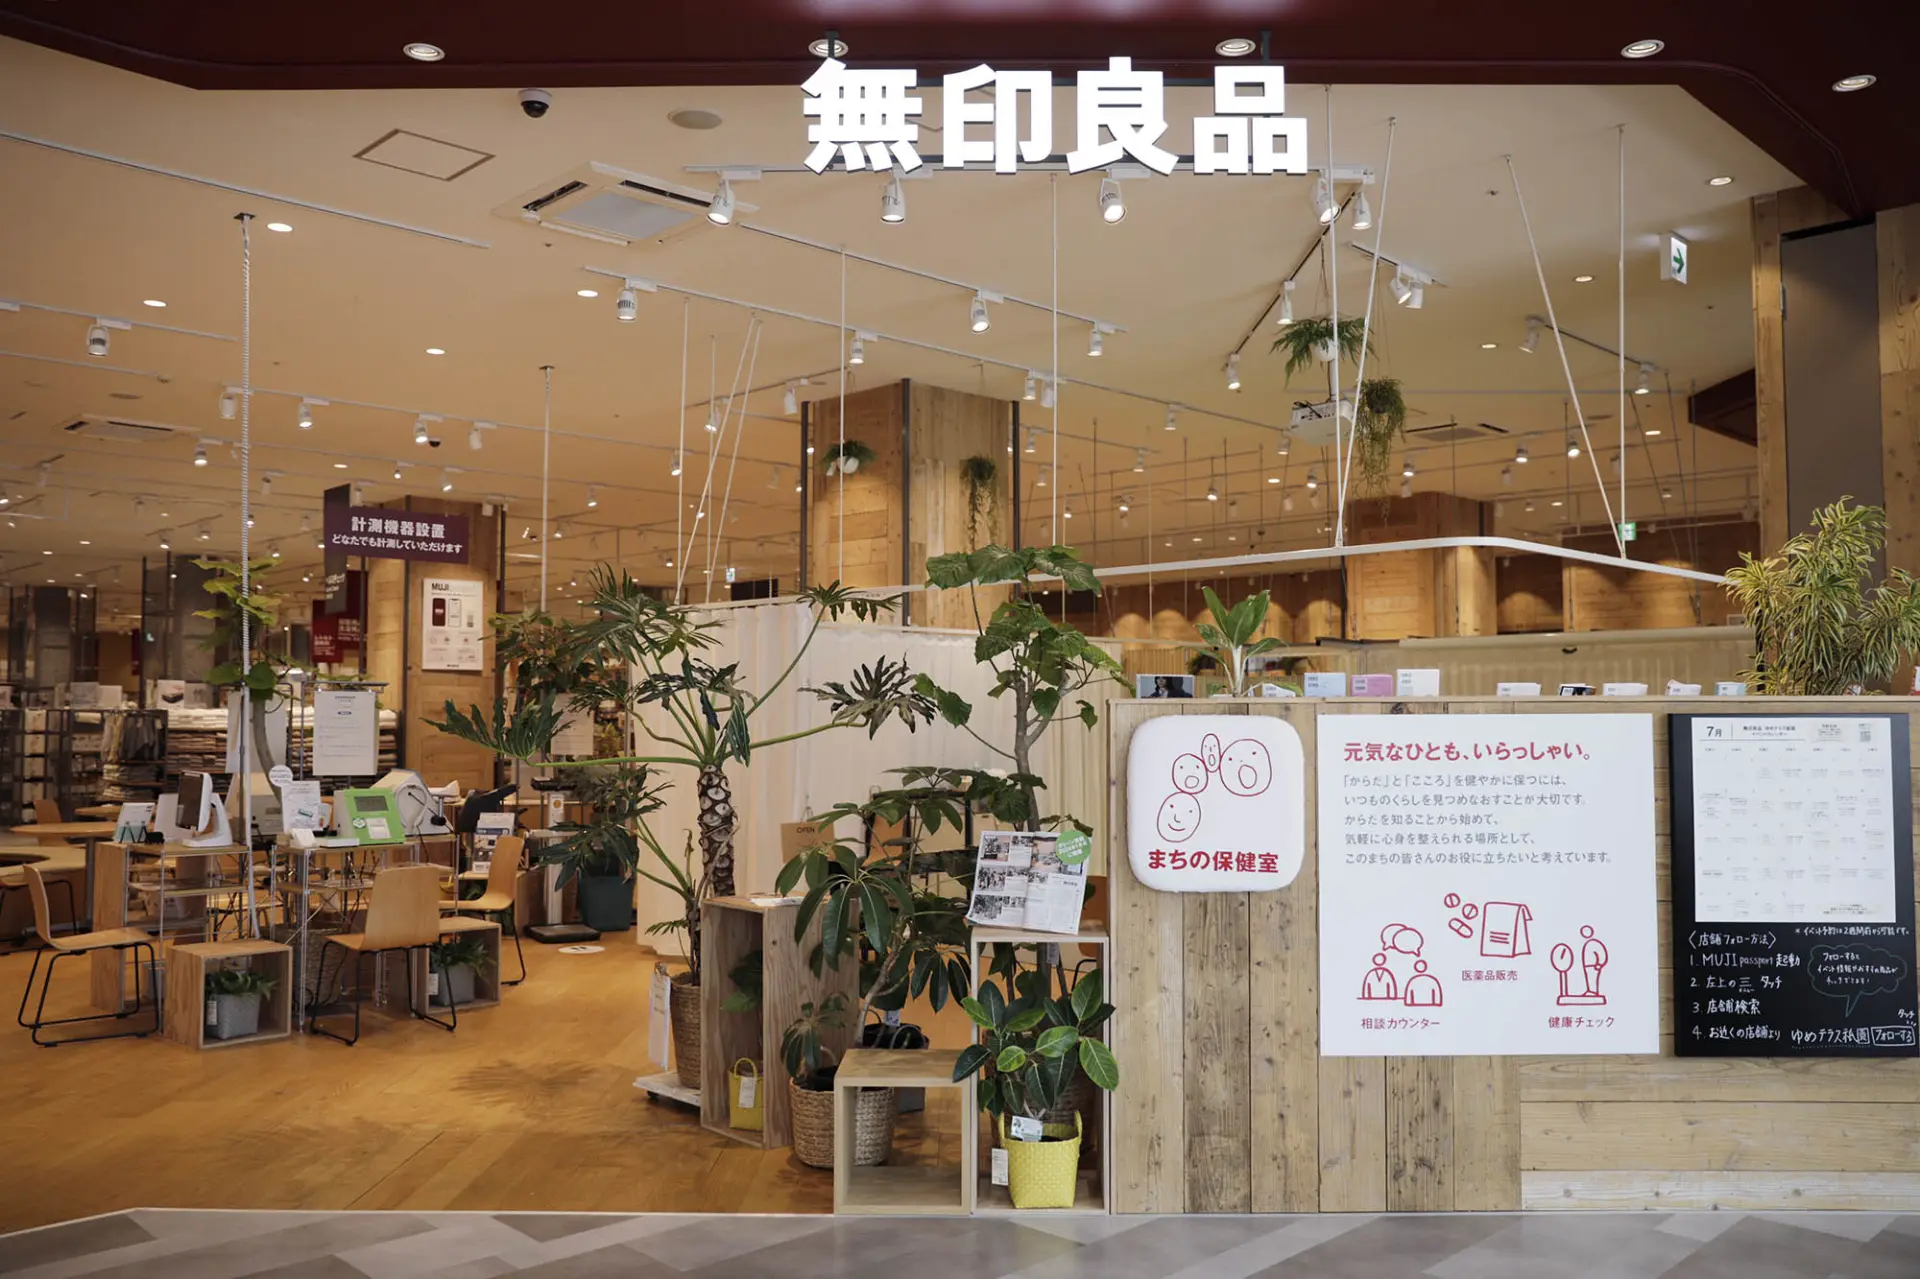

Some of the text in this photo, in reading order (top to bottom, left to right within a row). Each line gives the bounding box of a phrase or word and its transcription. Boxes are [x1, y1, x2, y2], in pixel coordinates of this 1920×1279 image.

[801, 57, 1308, 175] 無印良品
[351, 517, 445, 540] 計測機器設置
[332, 534, 463, 554] どなたでも計測していただけます
[1706, 726, 1723, 737] 7月
[1344, 742, 1591, 762] 元気なひとも、いらっしゃい。
[1345, 833, 1535, 845] 気軽に心身を整えられる場所として、
[1148, 849, 1279, 873] まちの保健室
[1346, 852, 1612, 864] このまちの皆さんのお役に立ちたいと考えています。
[1702, 953, 1737, 966] MUJI
[1462, 970, 1518, 982] 医薬品販売
[1706, 998, 1761, 1015] 店舗検索
[1361, 1017, 1441, 1030] 相談カウンター
[1549, 1015, 1615, 1029] 健康チェック
